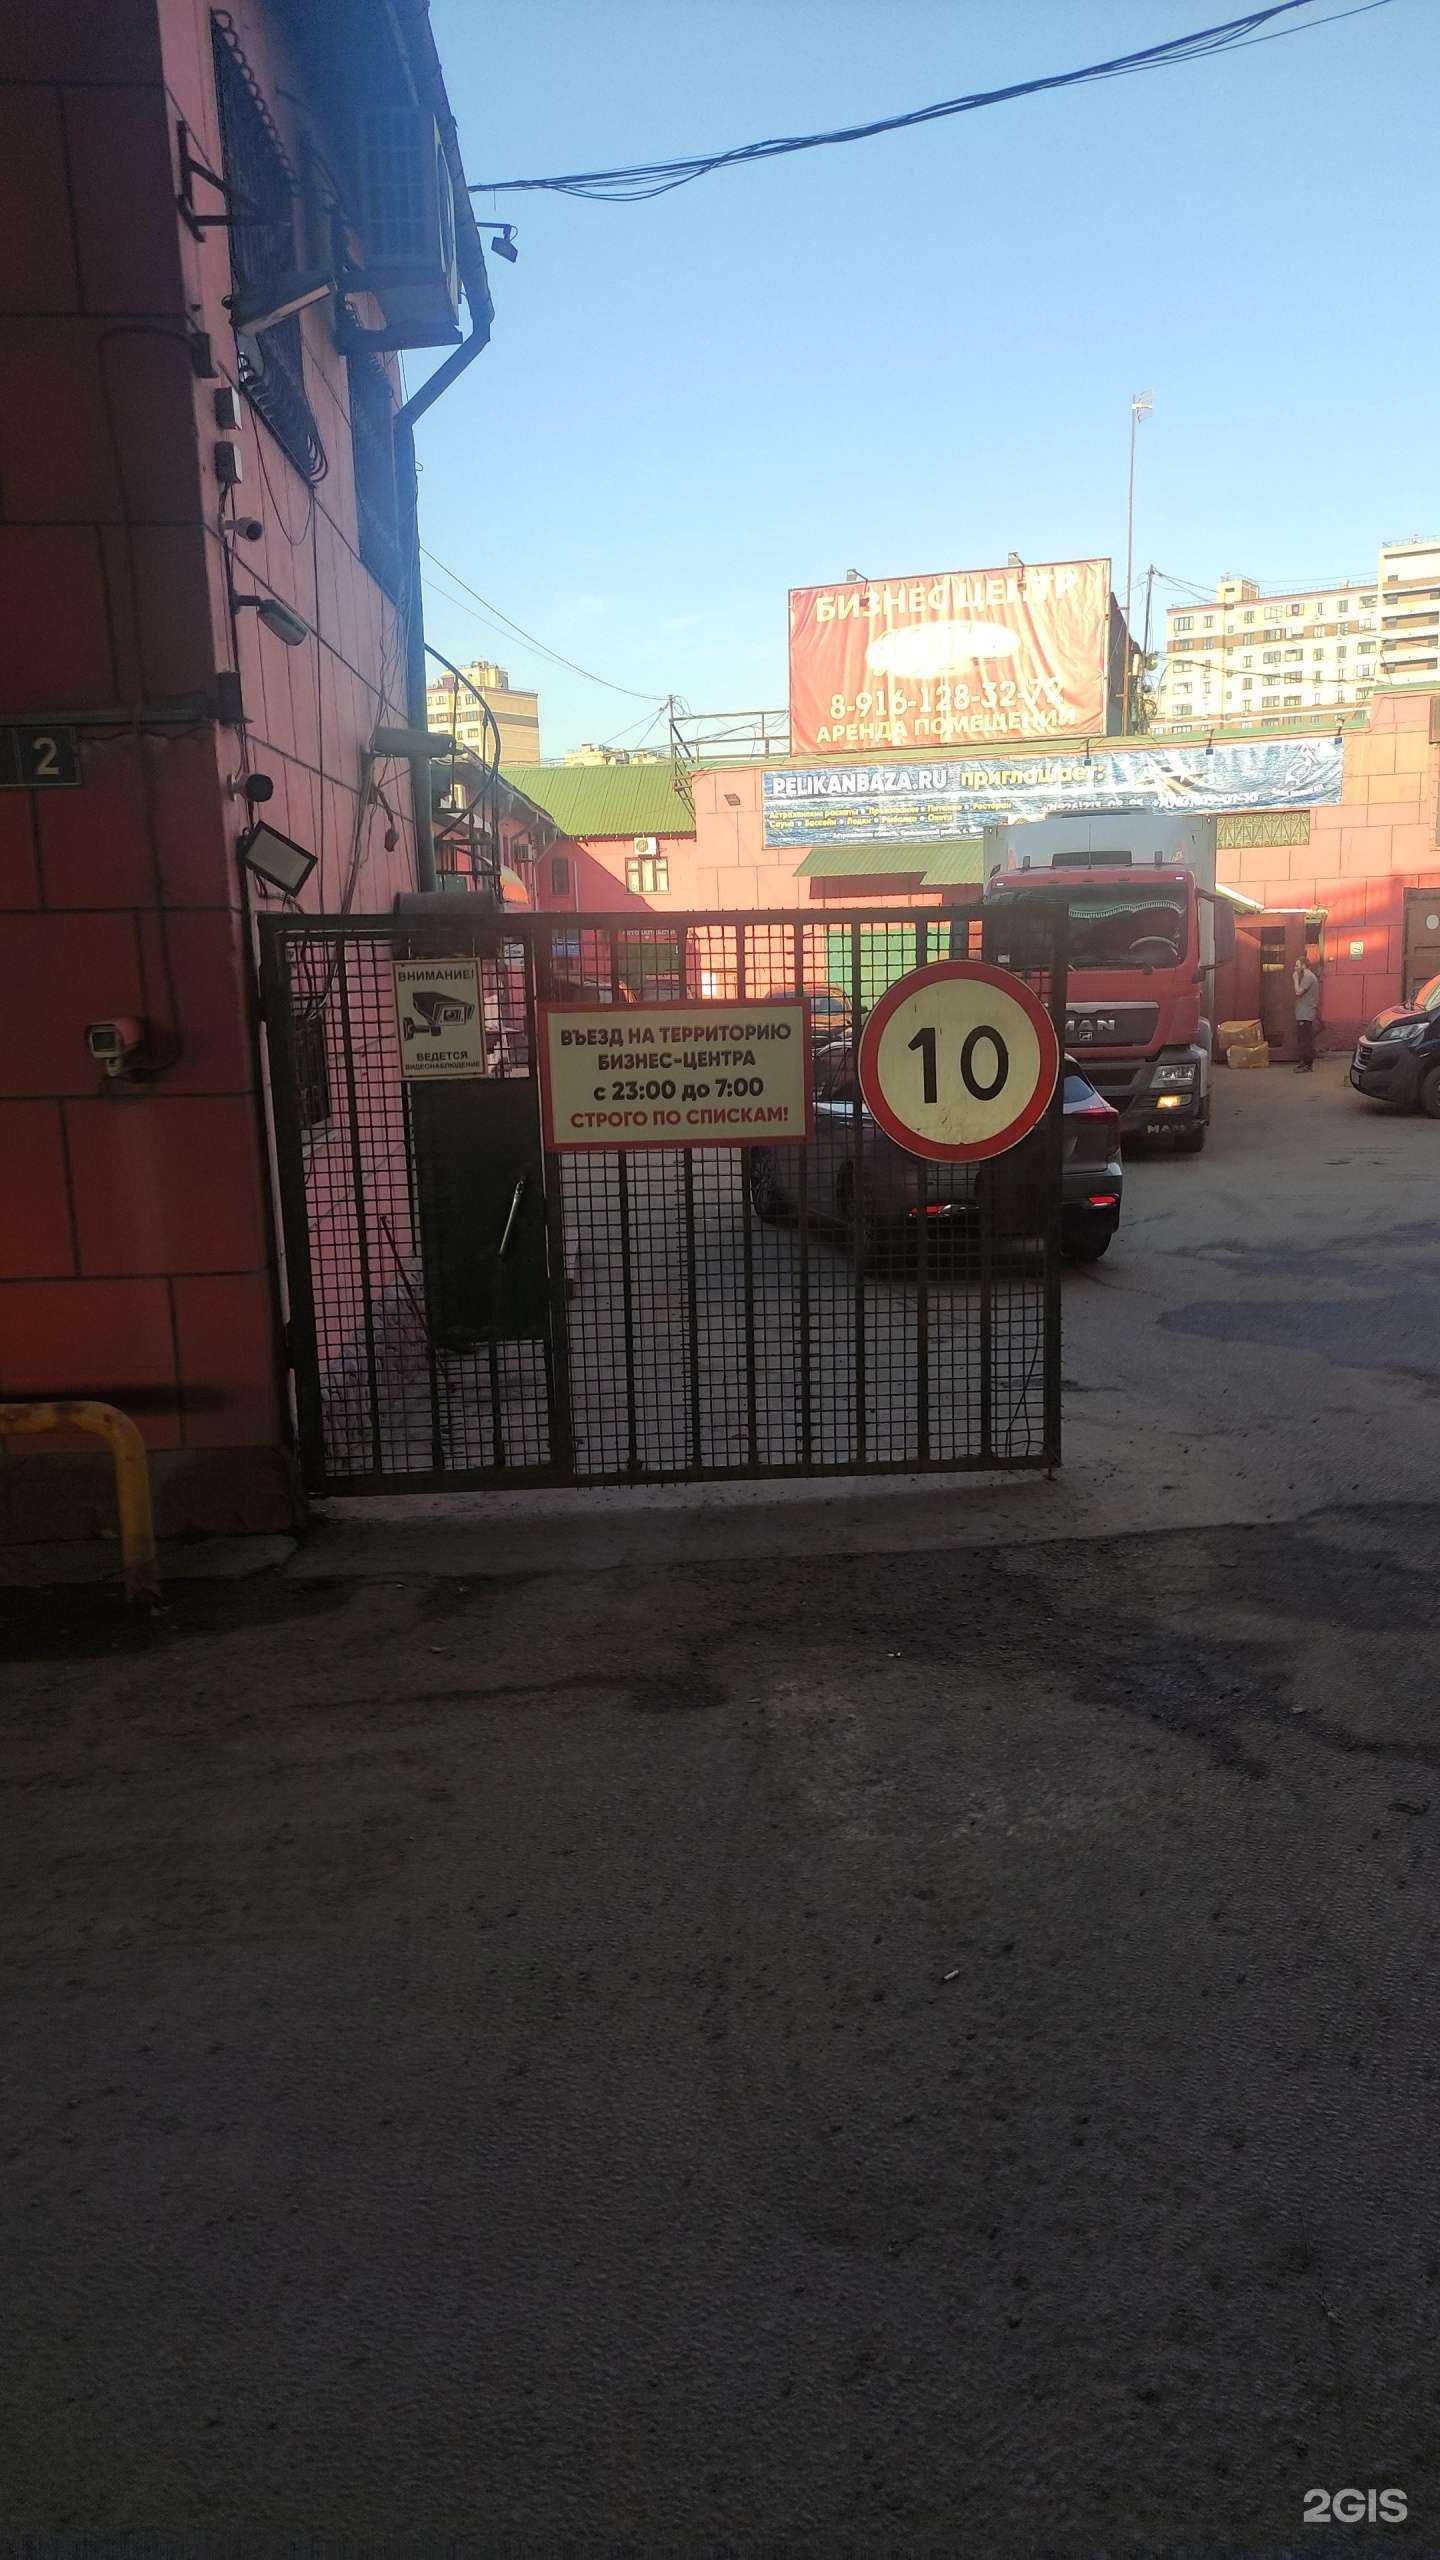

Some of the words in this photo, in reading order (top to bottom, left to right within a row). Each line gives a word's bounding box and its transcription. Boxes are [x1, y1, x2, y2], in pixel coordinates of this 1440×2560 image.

[815, 582, 947, 623] БИЗНЕС
[815, 717, 909, 744] АРЕНДА
[32, 737, 61, 775] 2
[772, 769, 949, 796] PELIKANBAZA.RU
[959, 765, 1106, 791] приглашает:
[397, 969, 475, 982] ВНИМАНИЕ!
[560, 1028, 624, 1048] ВЪЕЗД
[628, 1027, 655, 1045] НА
[659, 1022, 792, 1044] ТЕРРИТОРИЮ
[416, 1050, 468, 1062] ВЕДЕТСЯ
[597, 1049, 756, 1072] БИЗНЕС-ЦЕНТРА
[907, 1024, 1010, 1104] 10
[593, 1085, 606, 1101] с
[611, 1080, 677, 1101] 23:00
[681, 1082, 711, 1102] до
[714, 1076, 765, 1099] 7:00
[570, 1110, 648, 1129] СТРОГО
[652, 1109, 681, 1127] ПО
[686, 1106, 789, 1127] СПИСКАМ!
